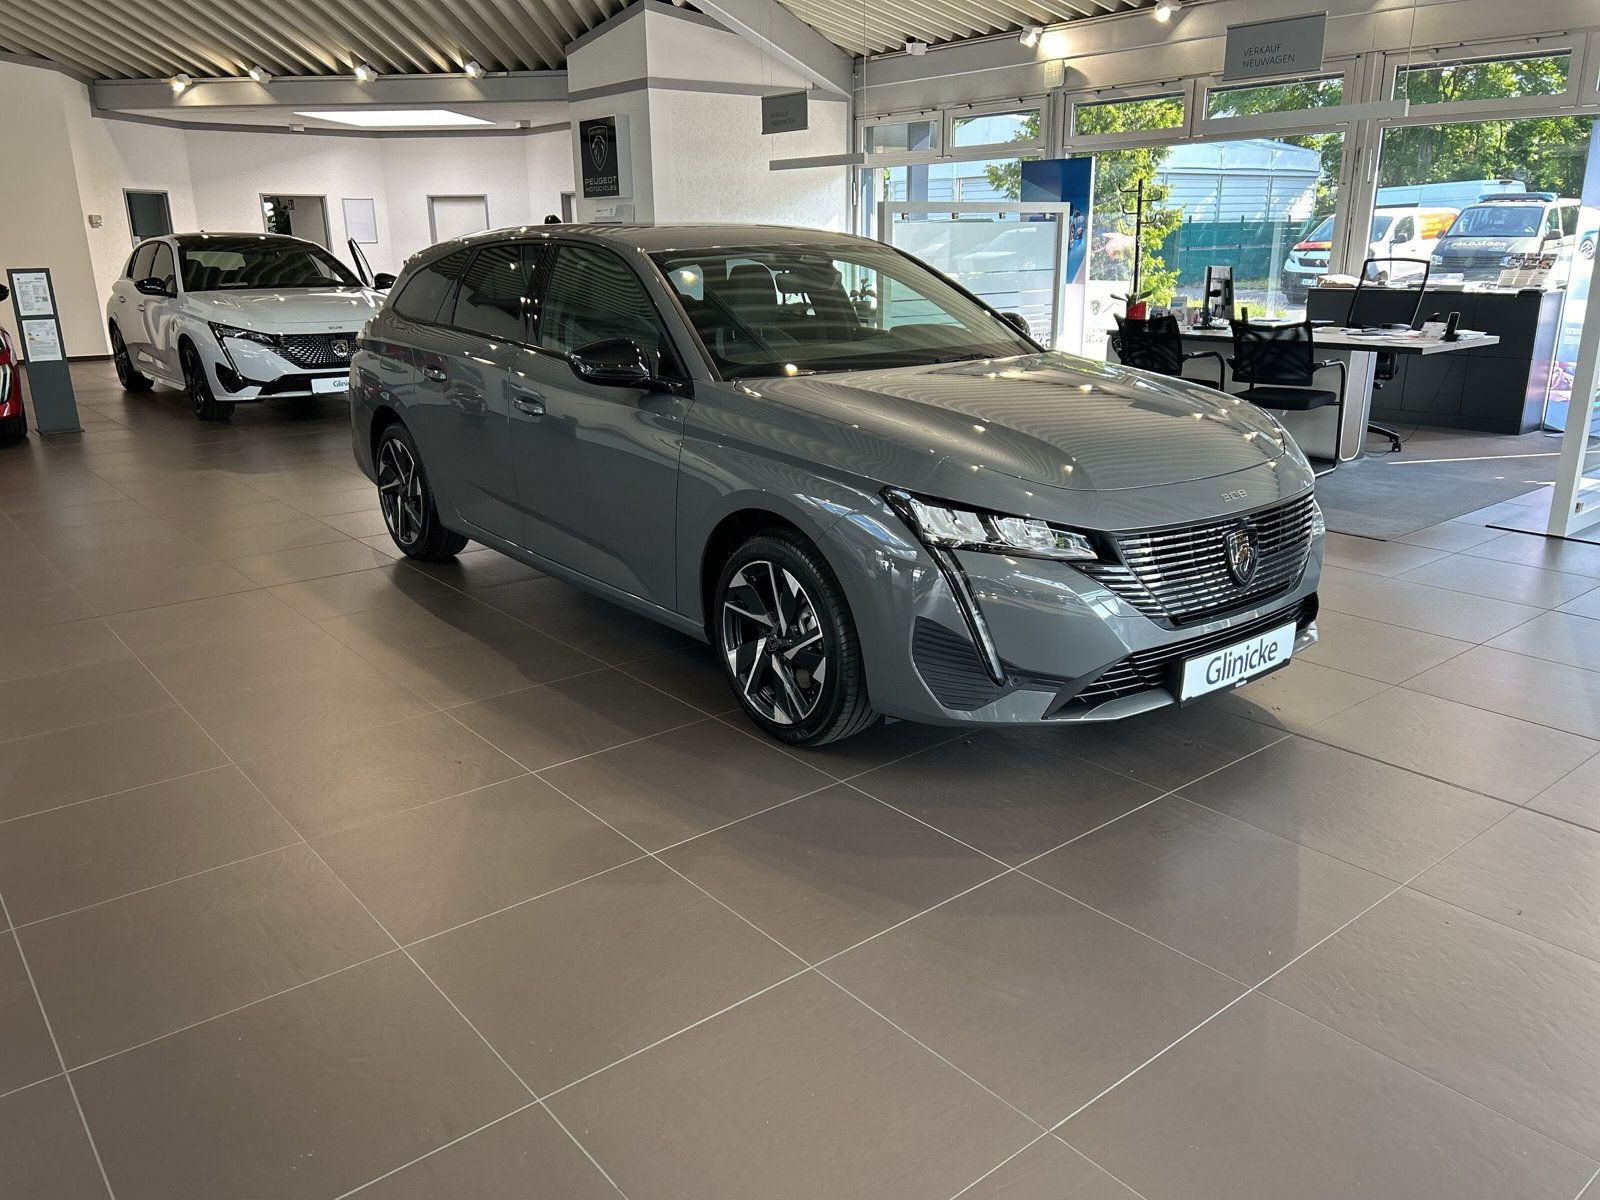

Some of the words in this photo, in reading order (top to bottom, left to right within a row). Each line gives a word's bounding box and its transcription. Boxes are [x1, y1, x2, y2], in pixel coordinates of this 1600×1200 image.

[1243, 43, 1282, 57] VERKAUF
[1242, 54, 1296, 68] NEUWAGEN
[585, 176, 617, 185] PEUGEOT
[585, 184, 617, 193] MOTOCYCLES
[1220, 489, 1247, 502] 308
[1206, 638, 1278, 685] Glinicke
